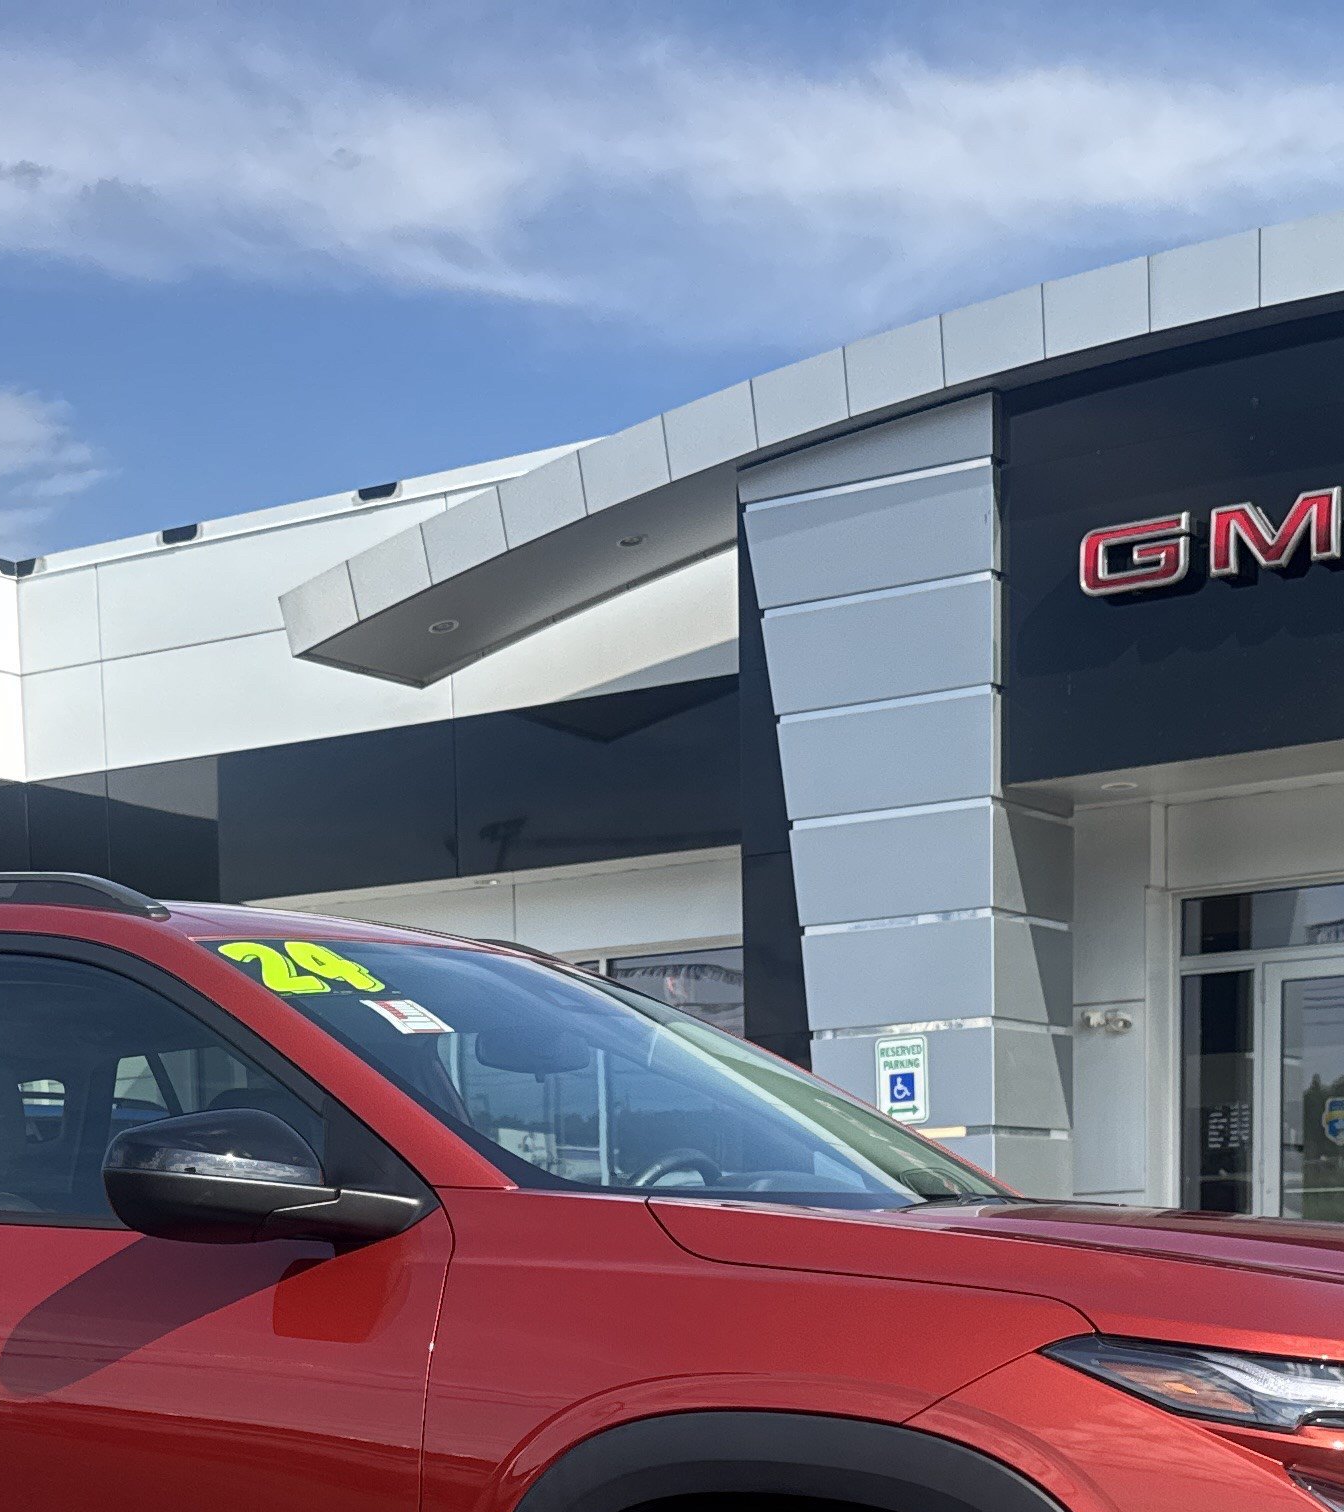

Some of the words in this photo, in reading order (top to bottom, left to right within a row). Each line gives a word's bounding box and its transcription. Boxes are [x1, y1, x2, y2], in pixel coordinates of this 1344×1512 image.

[218, 941, 386, 994] 24
[879, 1044, 923, 1058] RESERVED
[883, 1057, 921, 1071] PARKING
